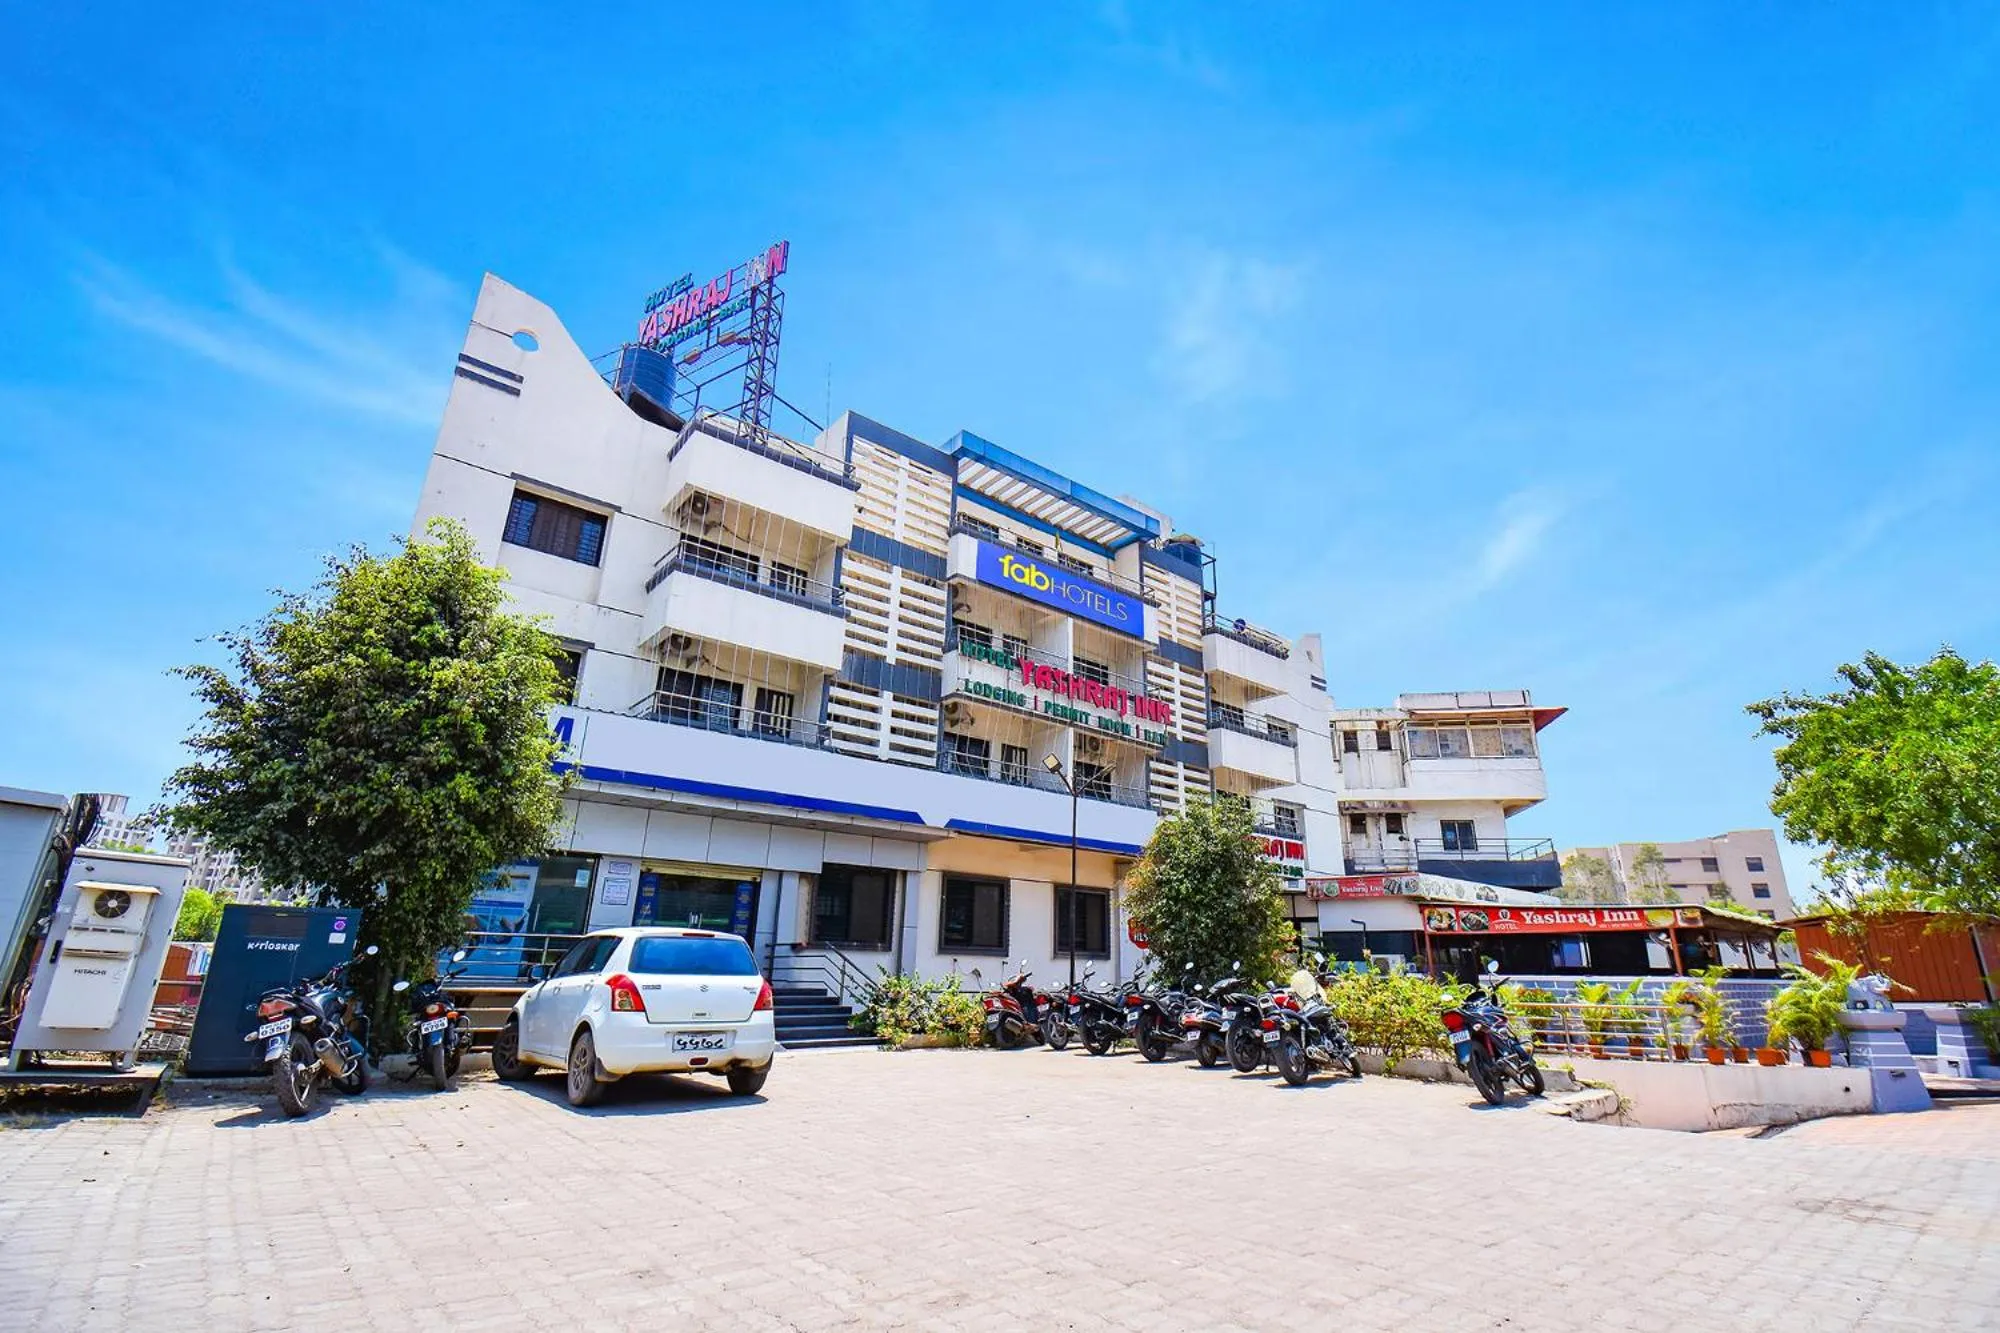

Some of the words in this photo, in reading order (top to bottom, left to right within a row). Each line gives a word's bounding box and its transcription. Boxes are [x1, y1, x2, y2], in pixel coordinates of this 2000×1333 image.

[638, 269, 733, 344] YASHRAJ
[961, 639, 1014, 671] HOTEL
[964, 678, 1026, 707] LODGING
[1044, 700, 1091, 725] PERMIT
[1018, 656, 1128, 718] YASHRAJ
[1135, 694, 1171, 726] INN
[1494, 922, 1521, 931] HOTEL
[1520, 910, 1597, 927] Yashraj
[1602, 910, 1641, 922] Inn
[74, 968, 107, 976] HITACHI
